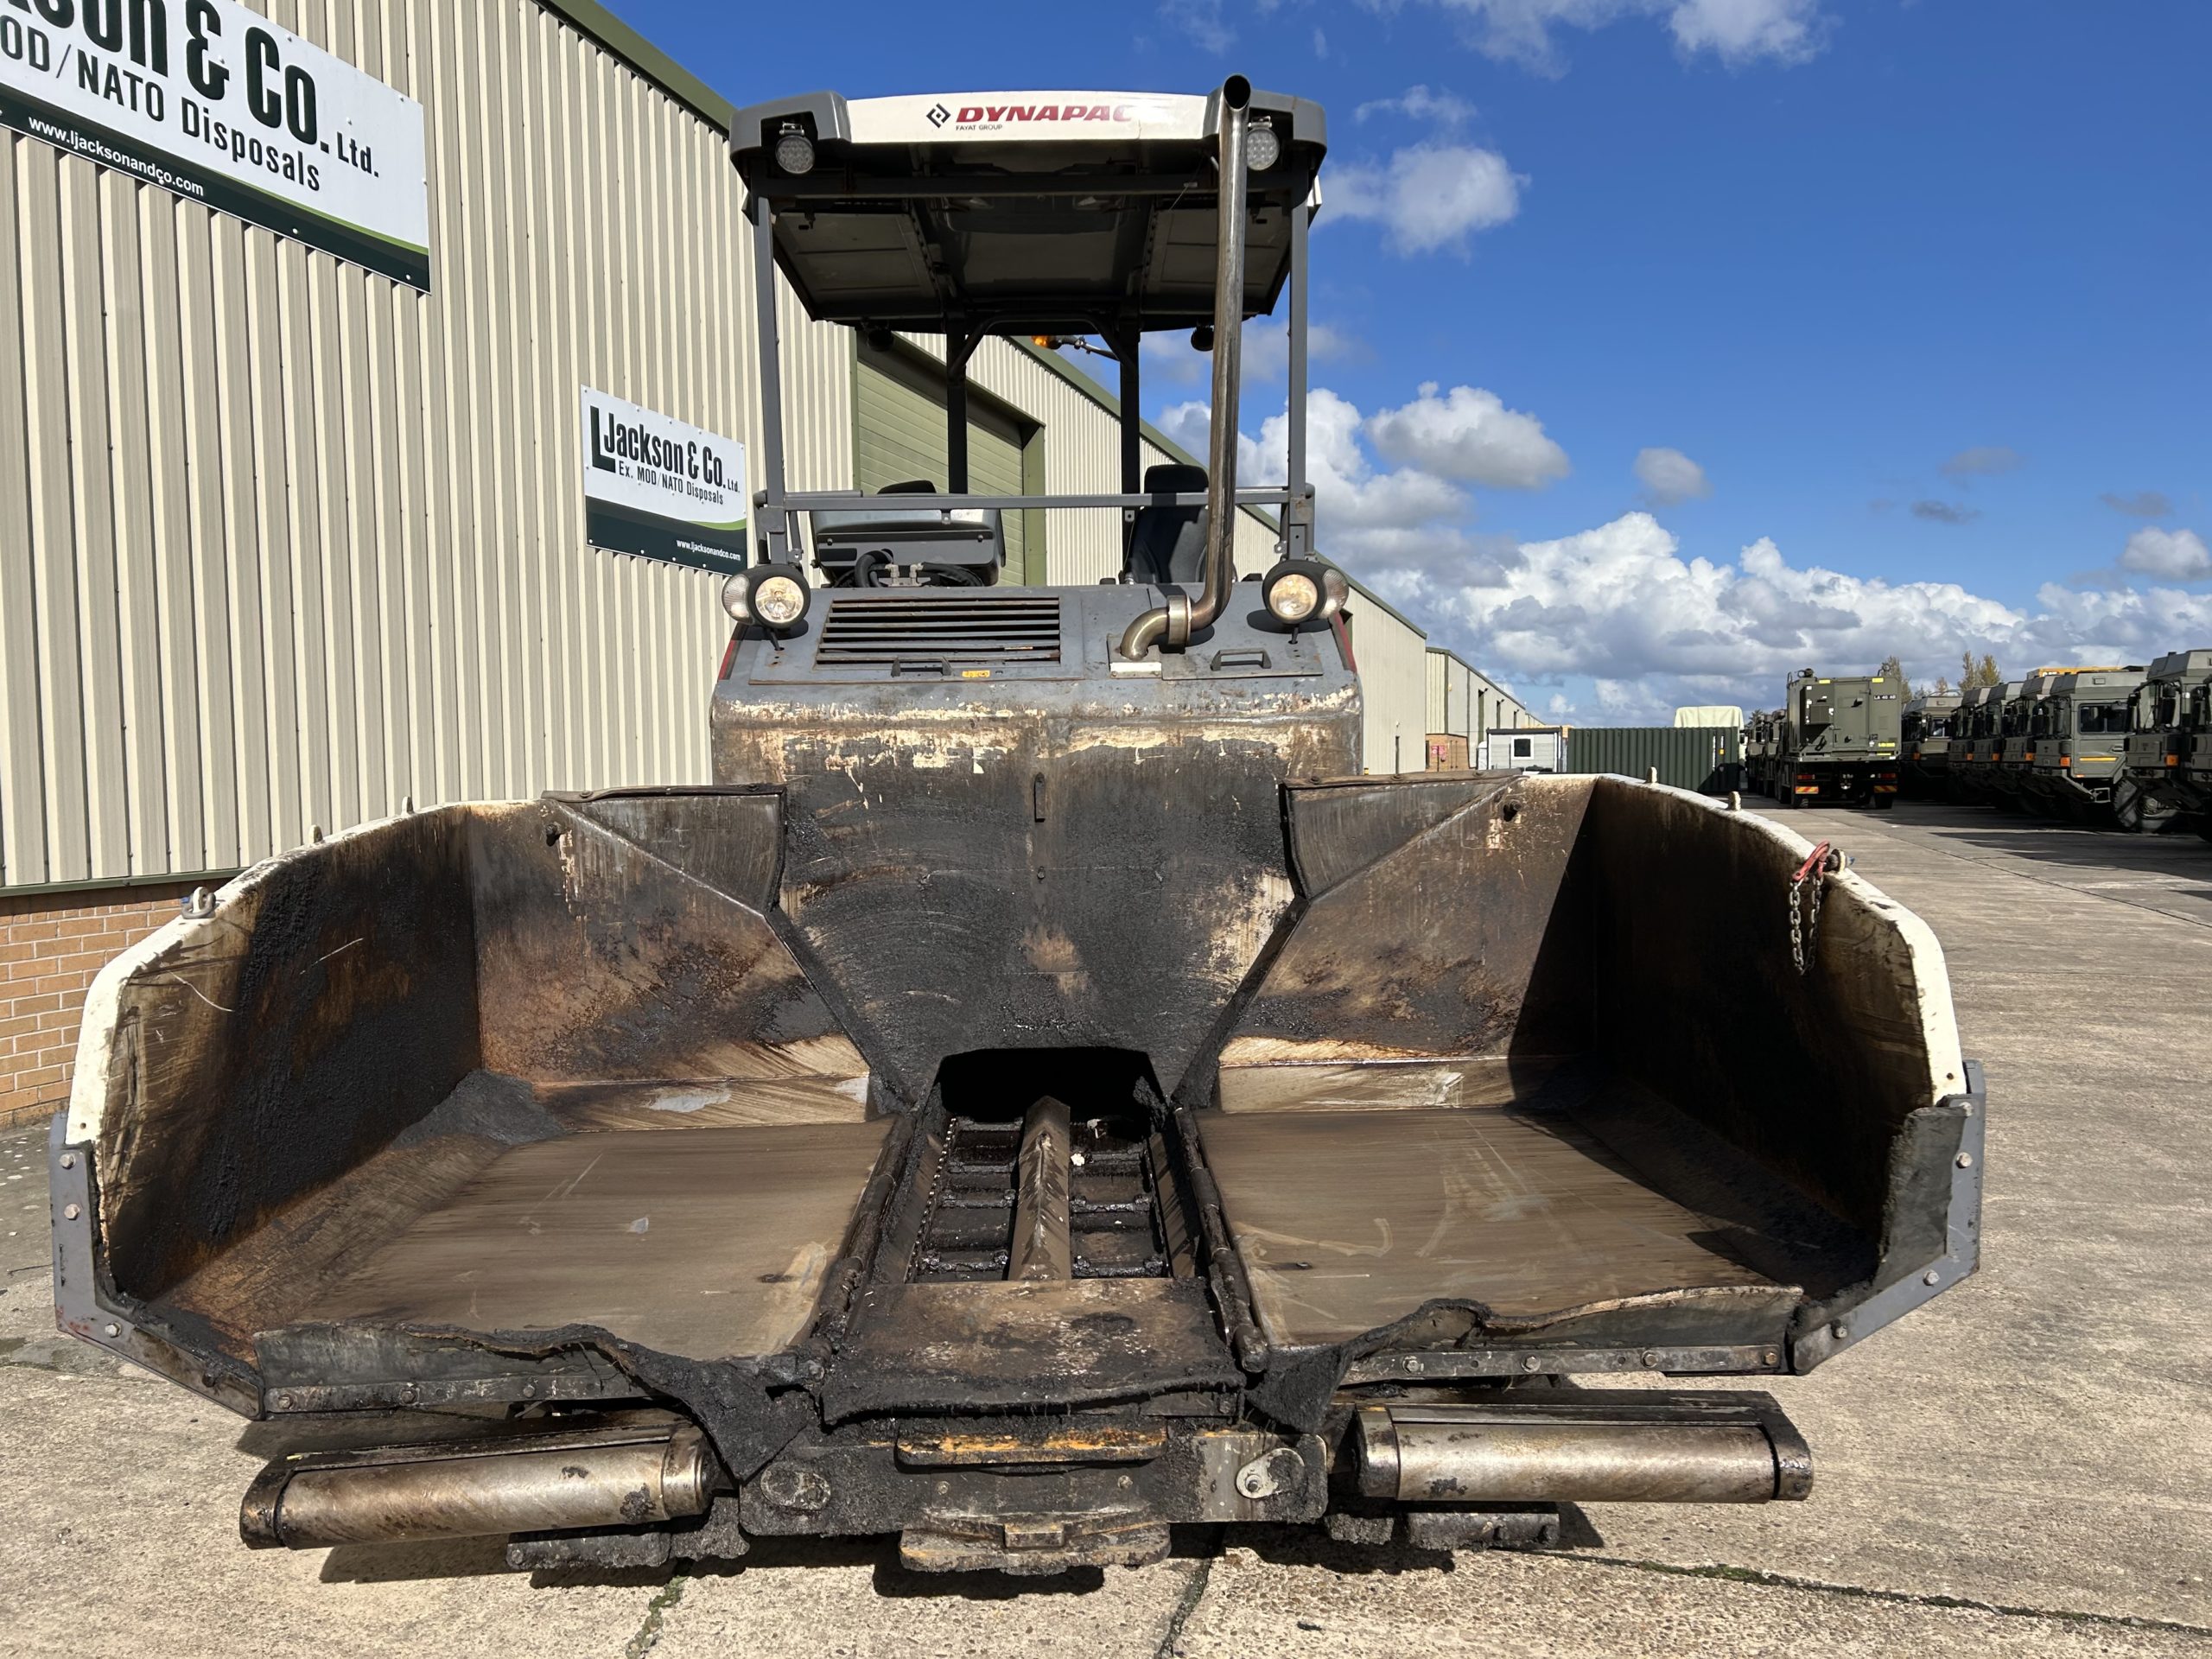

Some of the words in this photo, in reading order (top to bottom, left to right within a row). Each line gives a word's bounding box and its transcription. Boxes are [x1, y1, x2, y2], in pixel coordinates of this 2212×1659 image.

[185, 0, 230, 100] &
[245, 26, 329, 154] Co.
[336, 130, 379, 178] Ltd.
[956, 105, 1133, 123] DYNAPAC
[29, 117, 204, 197] www.ljacksonandco.com
[181, 96, 320, 192] Disposals
[619, 461, 633, 479] Ex.
[687, 480, 724, 505] Disposals
[688, 441, 699, 480] &
[702, 446, 727, 489] Co.
[728, 478, 741, 493] Ltd.
[676, 539, 741, 562] www.ljacksonandco.com
